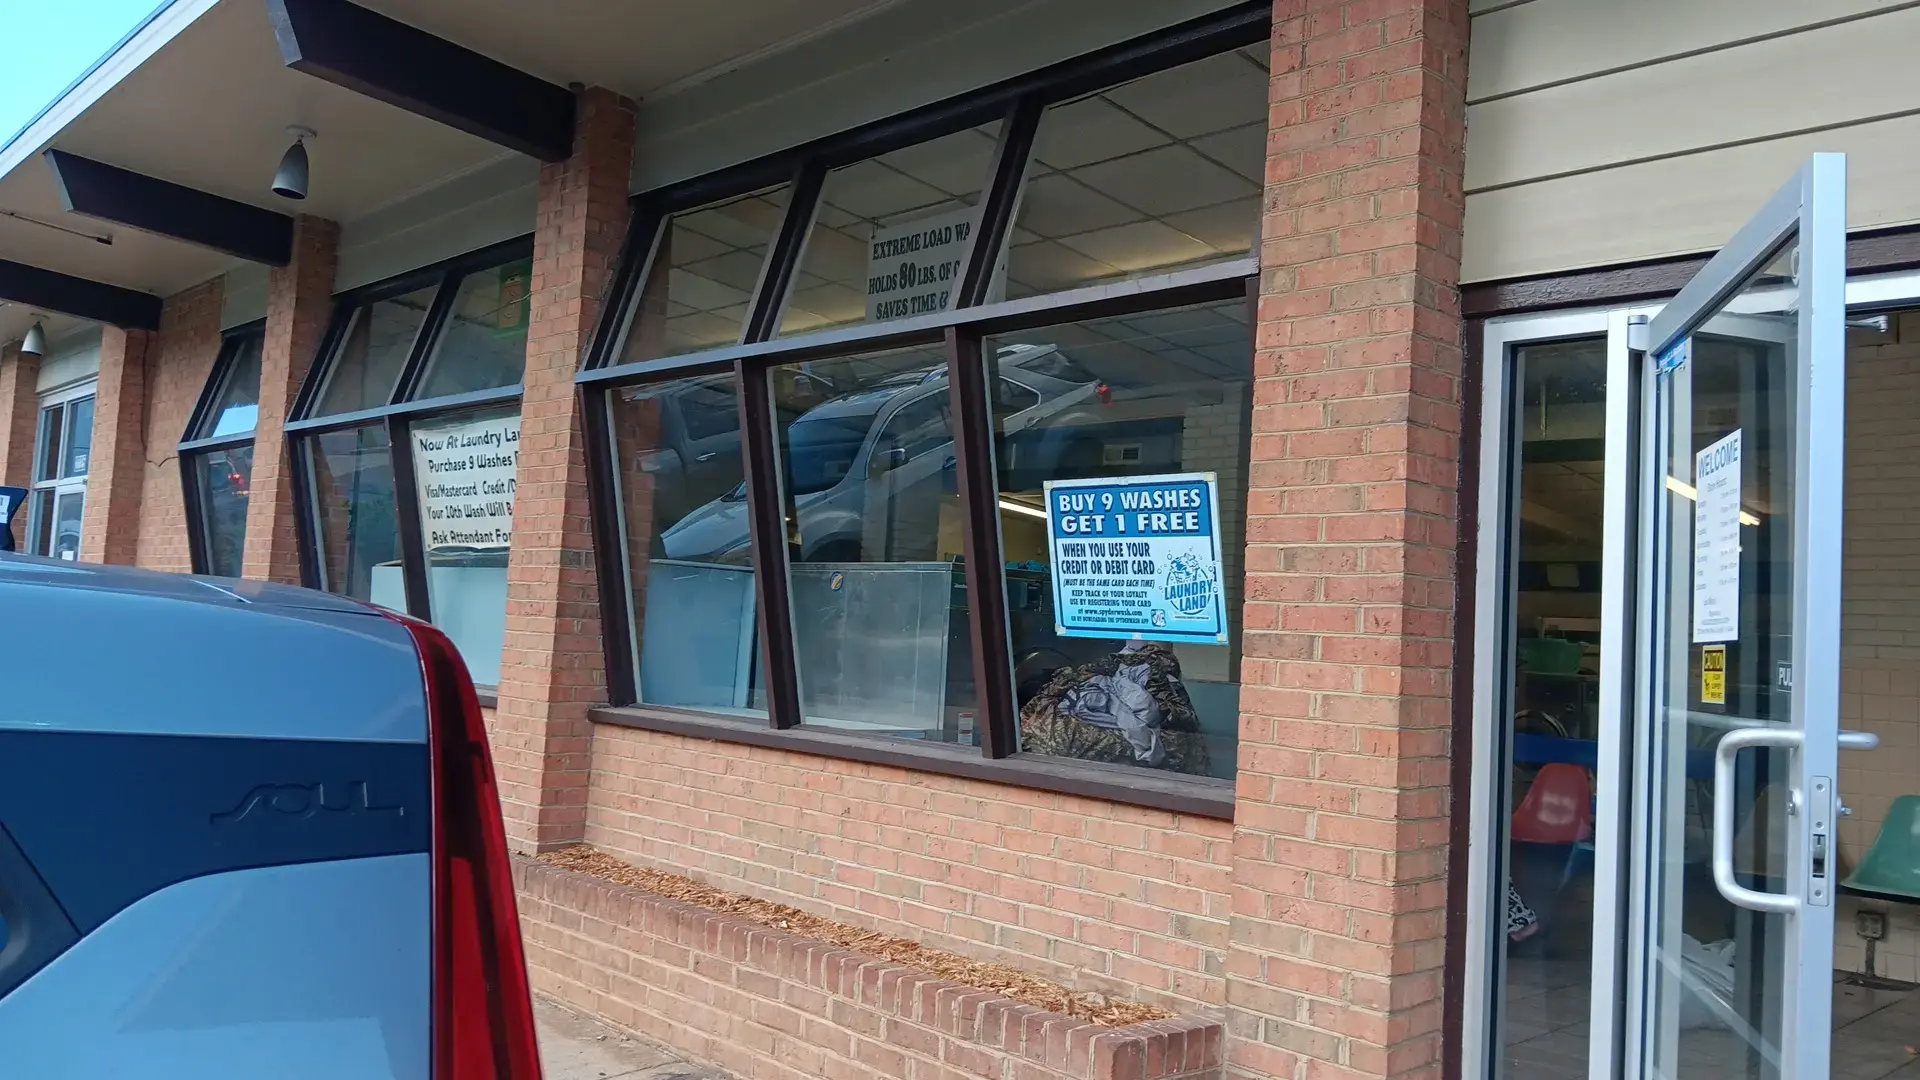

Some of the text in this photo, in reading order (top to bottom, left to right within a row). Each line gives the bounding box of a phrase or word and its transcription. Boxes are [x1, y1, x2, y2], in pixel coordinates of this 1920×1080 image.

[872, 234, 920, 260] EXTREME
[923, 226, 952, 249] LOAD
[868, 273, 898, 295] HOLDS
[900, 262, 916, 289] 80
[918, 265, 936, 286] LBS.
[939, 262, 952, 281] OF
[876, 291, 948, 320] SAVES TIME &
[419, 428, 520, 452] Now At Laundry La
[428, 458, 466, 473] Purchase
[469, 456, 474, 469] 9
[476, 453, 512, 468] Washes
[1699, 438, 1738, 478] WELCOME
[425, 482, 477, 498] Visa/Mastercard
[483, 479, 505, 494] Credit
[426, 501, 513, 520] Your 10th Wash Will B
[1059, 488, 1201, 513] BUY 9 WASHES
[1061, 512, 1199, 534] GET 1 FREE
[432, 531, 448, 545] Ask
[450, 530, 494, 544] Attendant
[1062, 542, 1150, 557] WHEN YOU USE YOUR
[1061, 560, 1155, 574] CREDIT OR DEBIT CARD
[1063, 578, 1078, 587] (MUST
[1111, 579, 1125, 587] CARD
[1126, 579, 1139, 587] EACH
[1140, 579, 1155, 589] TIME)
[1165, 579, 1213, 600] LAUNDRY
[1110, 590, 1125, 598] YOUR
[1126, 590, 1147, 598] LOYALTY
[1180, 595, 1206, 612] LAND
[210, 780, 404, 825] SOUL
